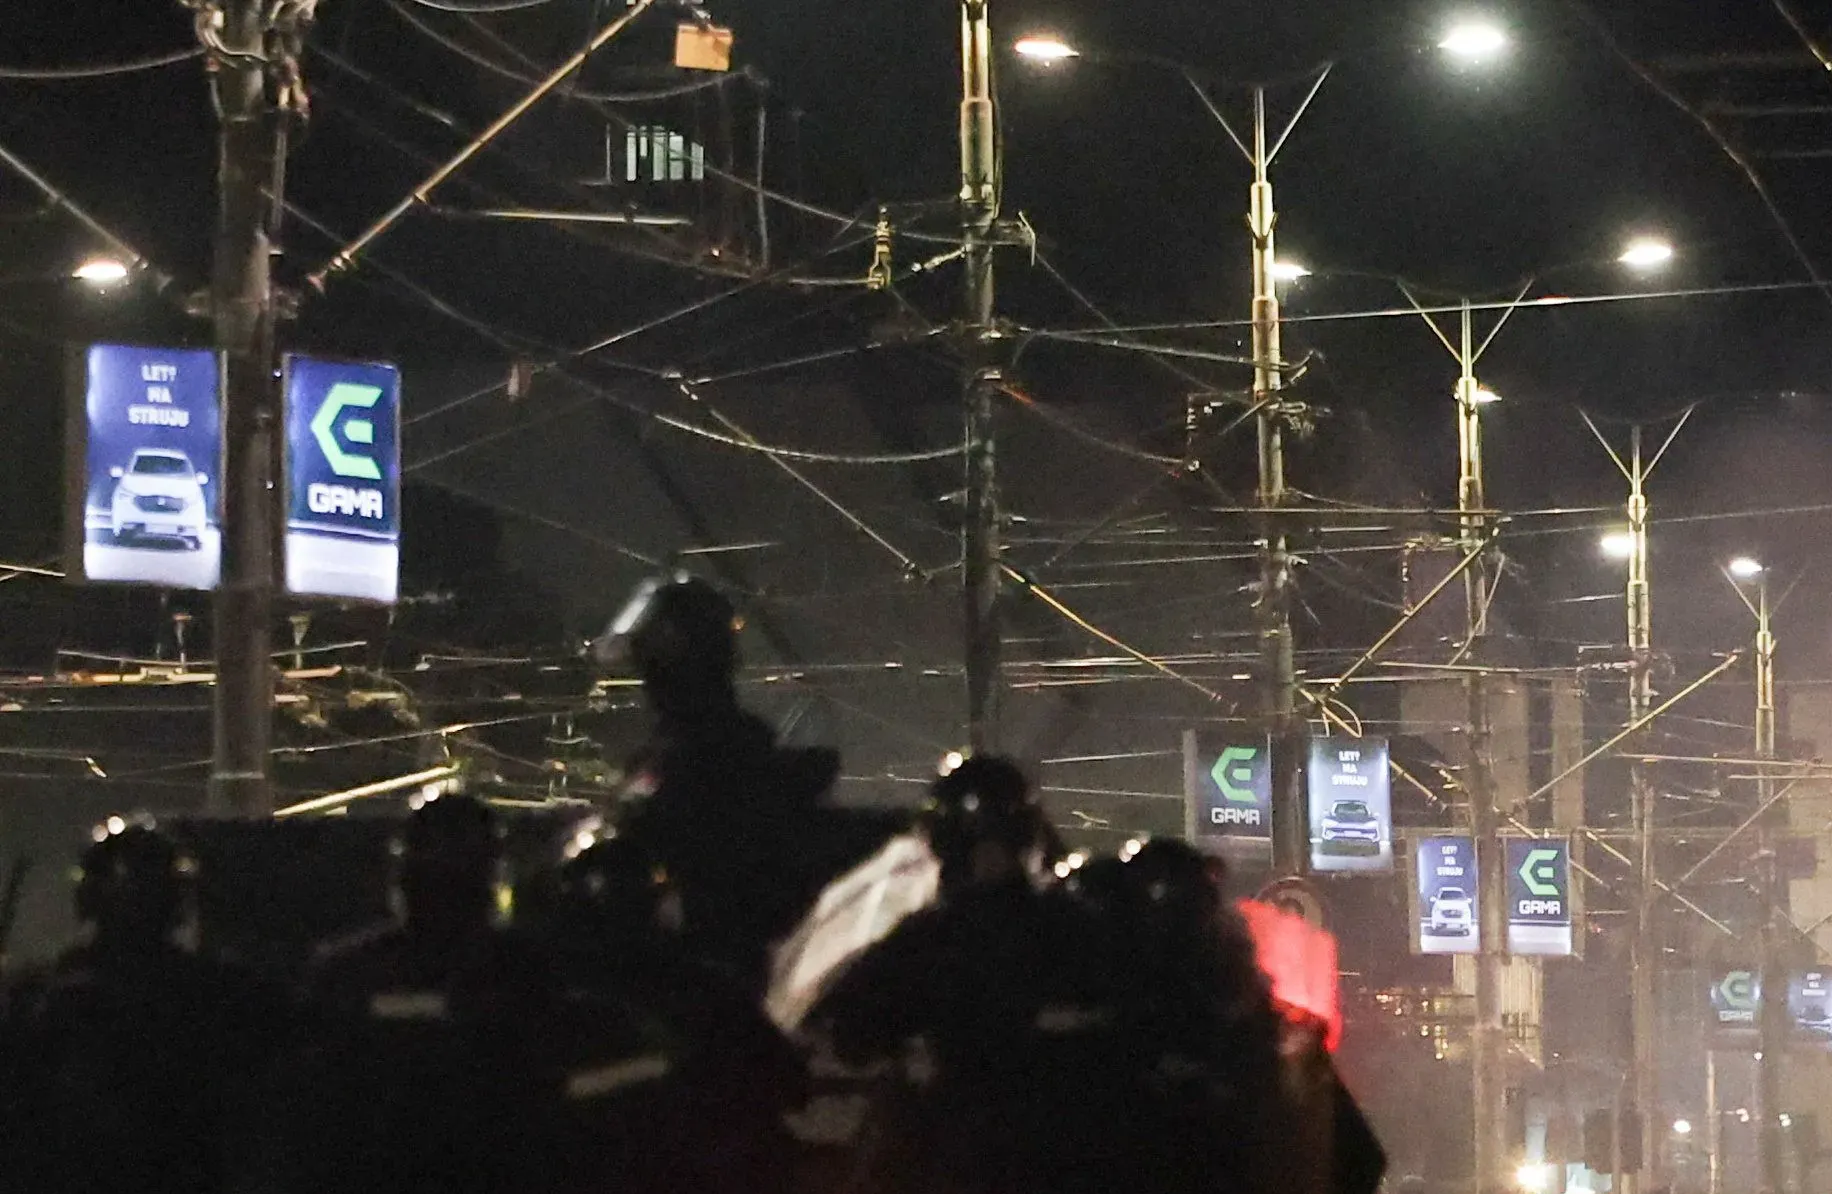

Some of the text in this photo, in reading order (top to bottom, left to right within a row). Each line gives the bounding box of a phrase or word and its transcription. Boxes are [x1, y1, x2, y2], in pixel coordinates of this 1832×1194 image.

[147, 386, 172, 404] NA
[308, 484, 383, 519] GAMA
[1211, 807, 1261, 826] GAMA
[1519, 900, 1561, 915] GAMA
